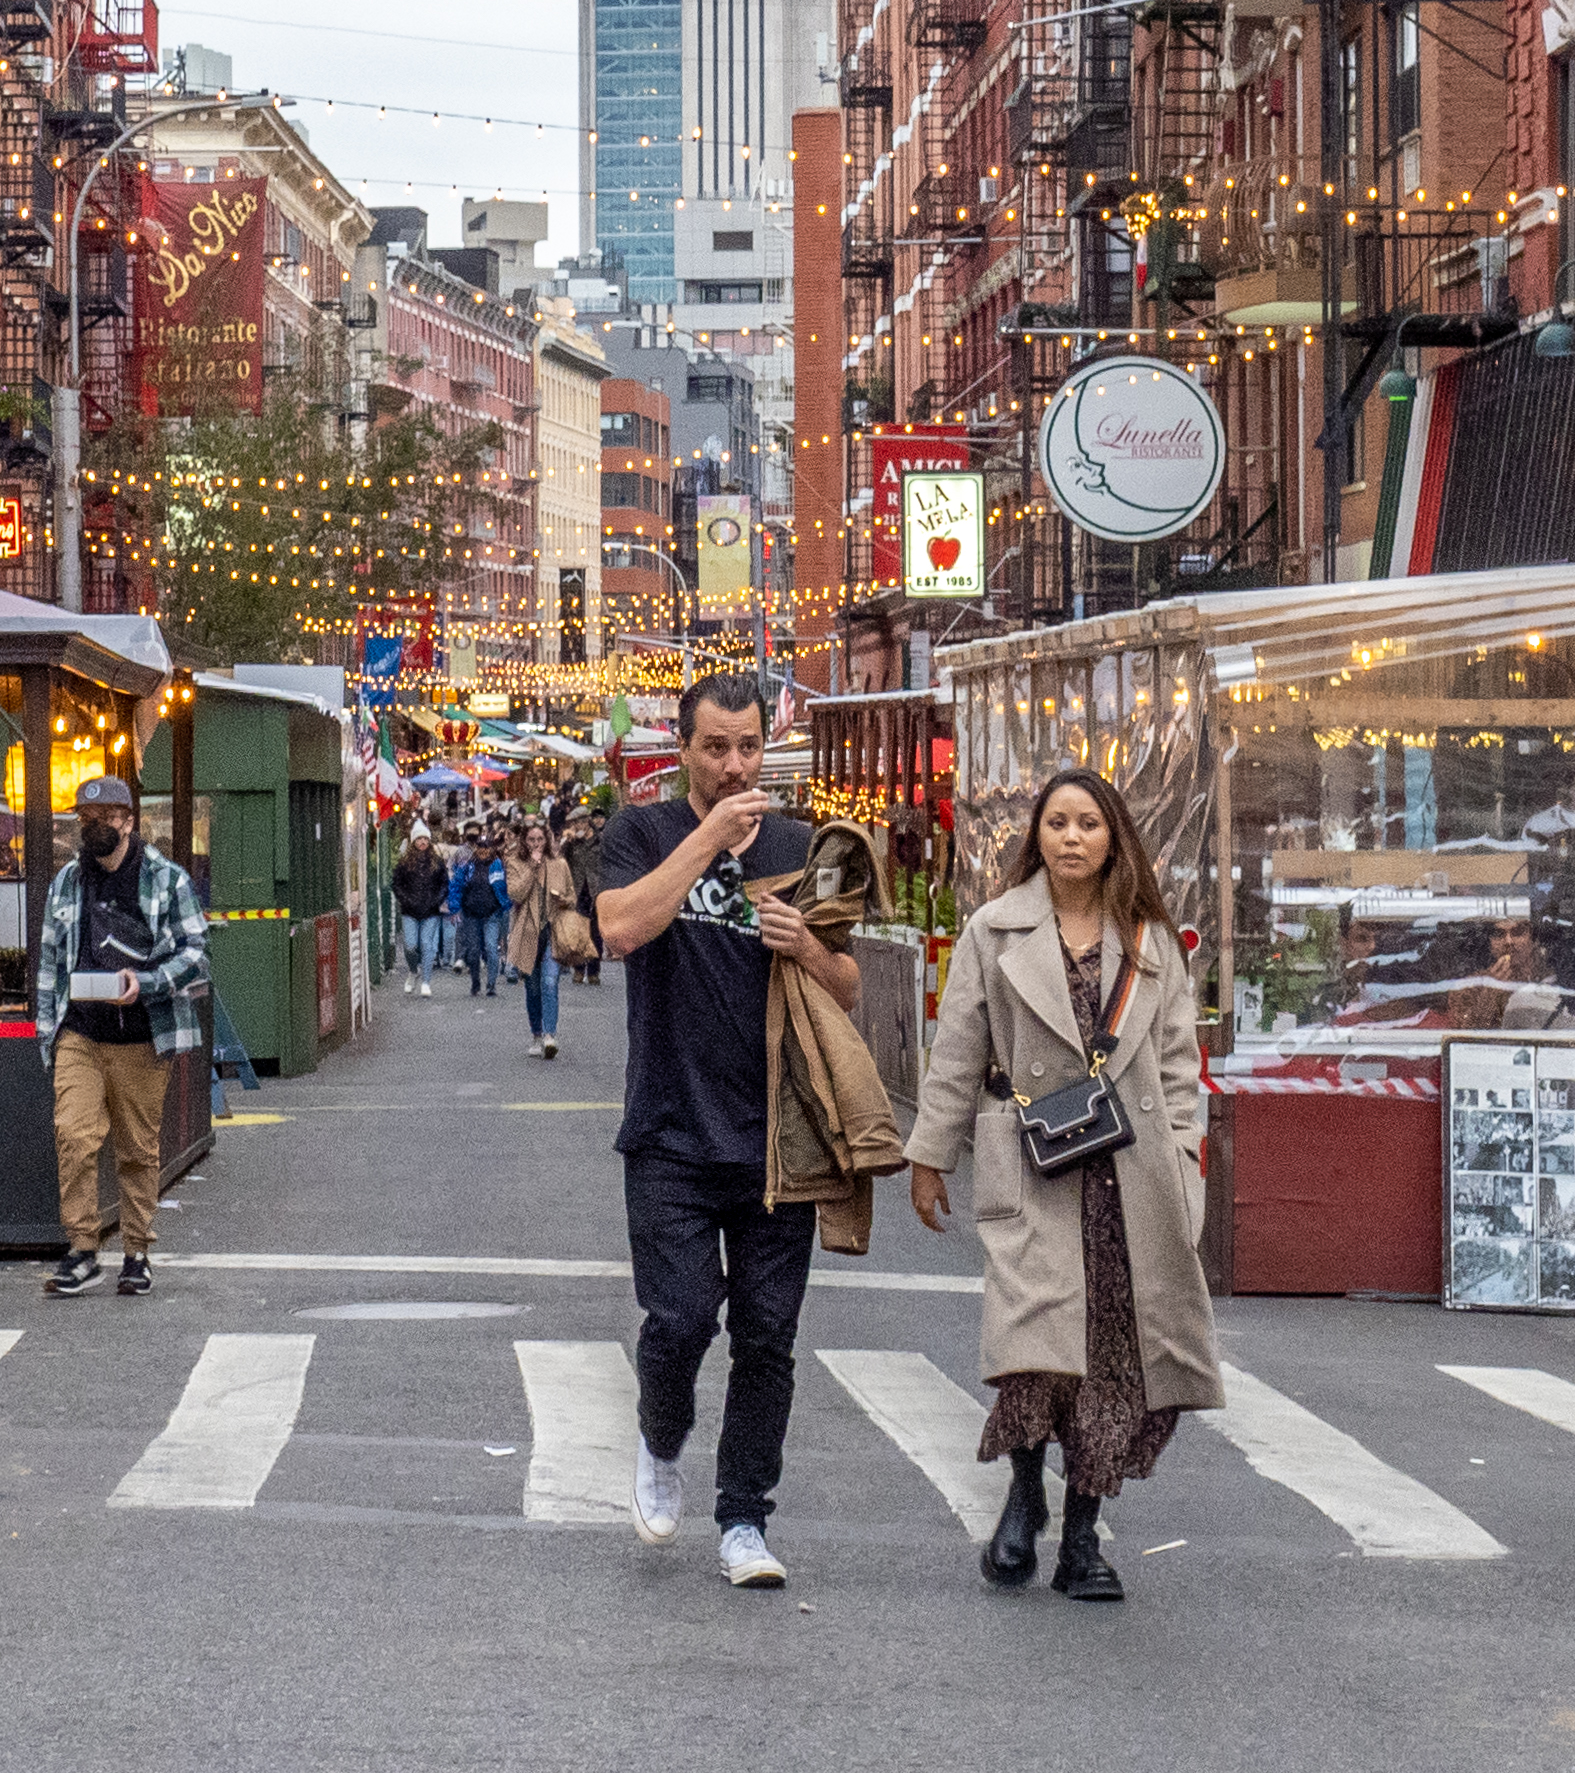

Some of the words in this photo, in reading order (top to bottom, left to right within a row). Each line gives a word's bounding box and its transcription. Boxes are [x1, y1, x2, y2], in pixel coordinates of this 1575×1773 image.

[147, 248, 207, 308] Da
[1092, 412, 1202, 450] Lunella
[914, 483, 950, 512] LA
[917, 502, 975, 532] MELA
[916, 576, 939, 587] EST
[946, 576, 973, 587] 1985
